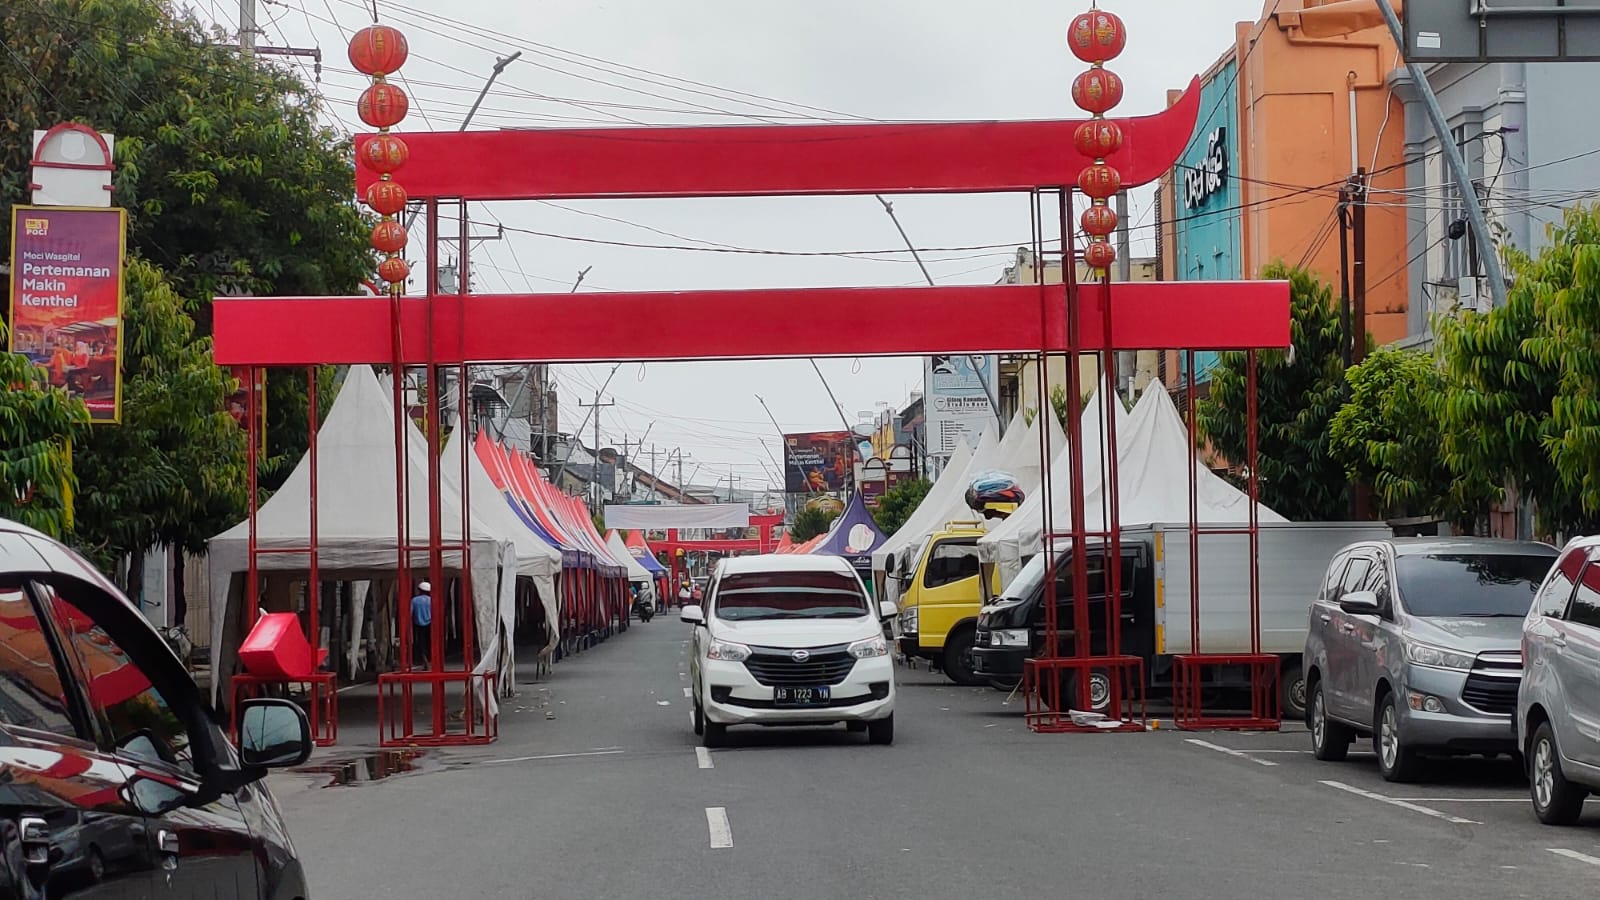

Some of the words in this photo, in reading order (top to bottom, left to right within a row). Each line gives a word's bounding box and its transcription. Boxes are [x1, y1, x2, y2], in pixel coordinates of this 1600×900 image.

[26, 228, 47, 236] POCI
[23, 251, 44, 260] Moci
[45, 252, 81, 262] Wasgitel
[23, 263, 110, 278] Pertemanan
[22, 278, 66, 292] Makin
[22, 293, 78, 307] Kenthel
[776, 689, 787, 699] AB
[793, 689, 812, 699] 1223
